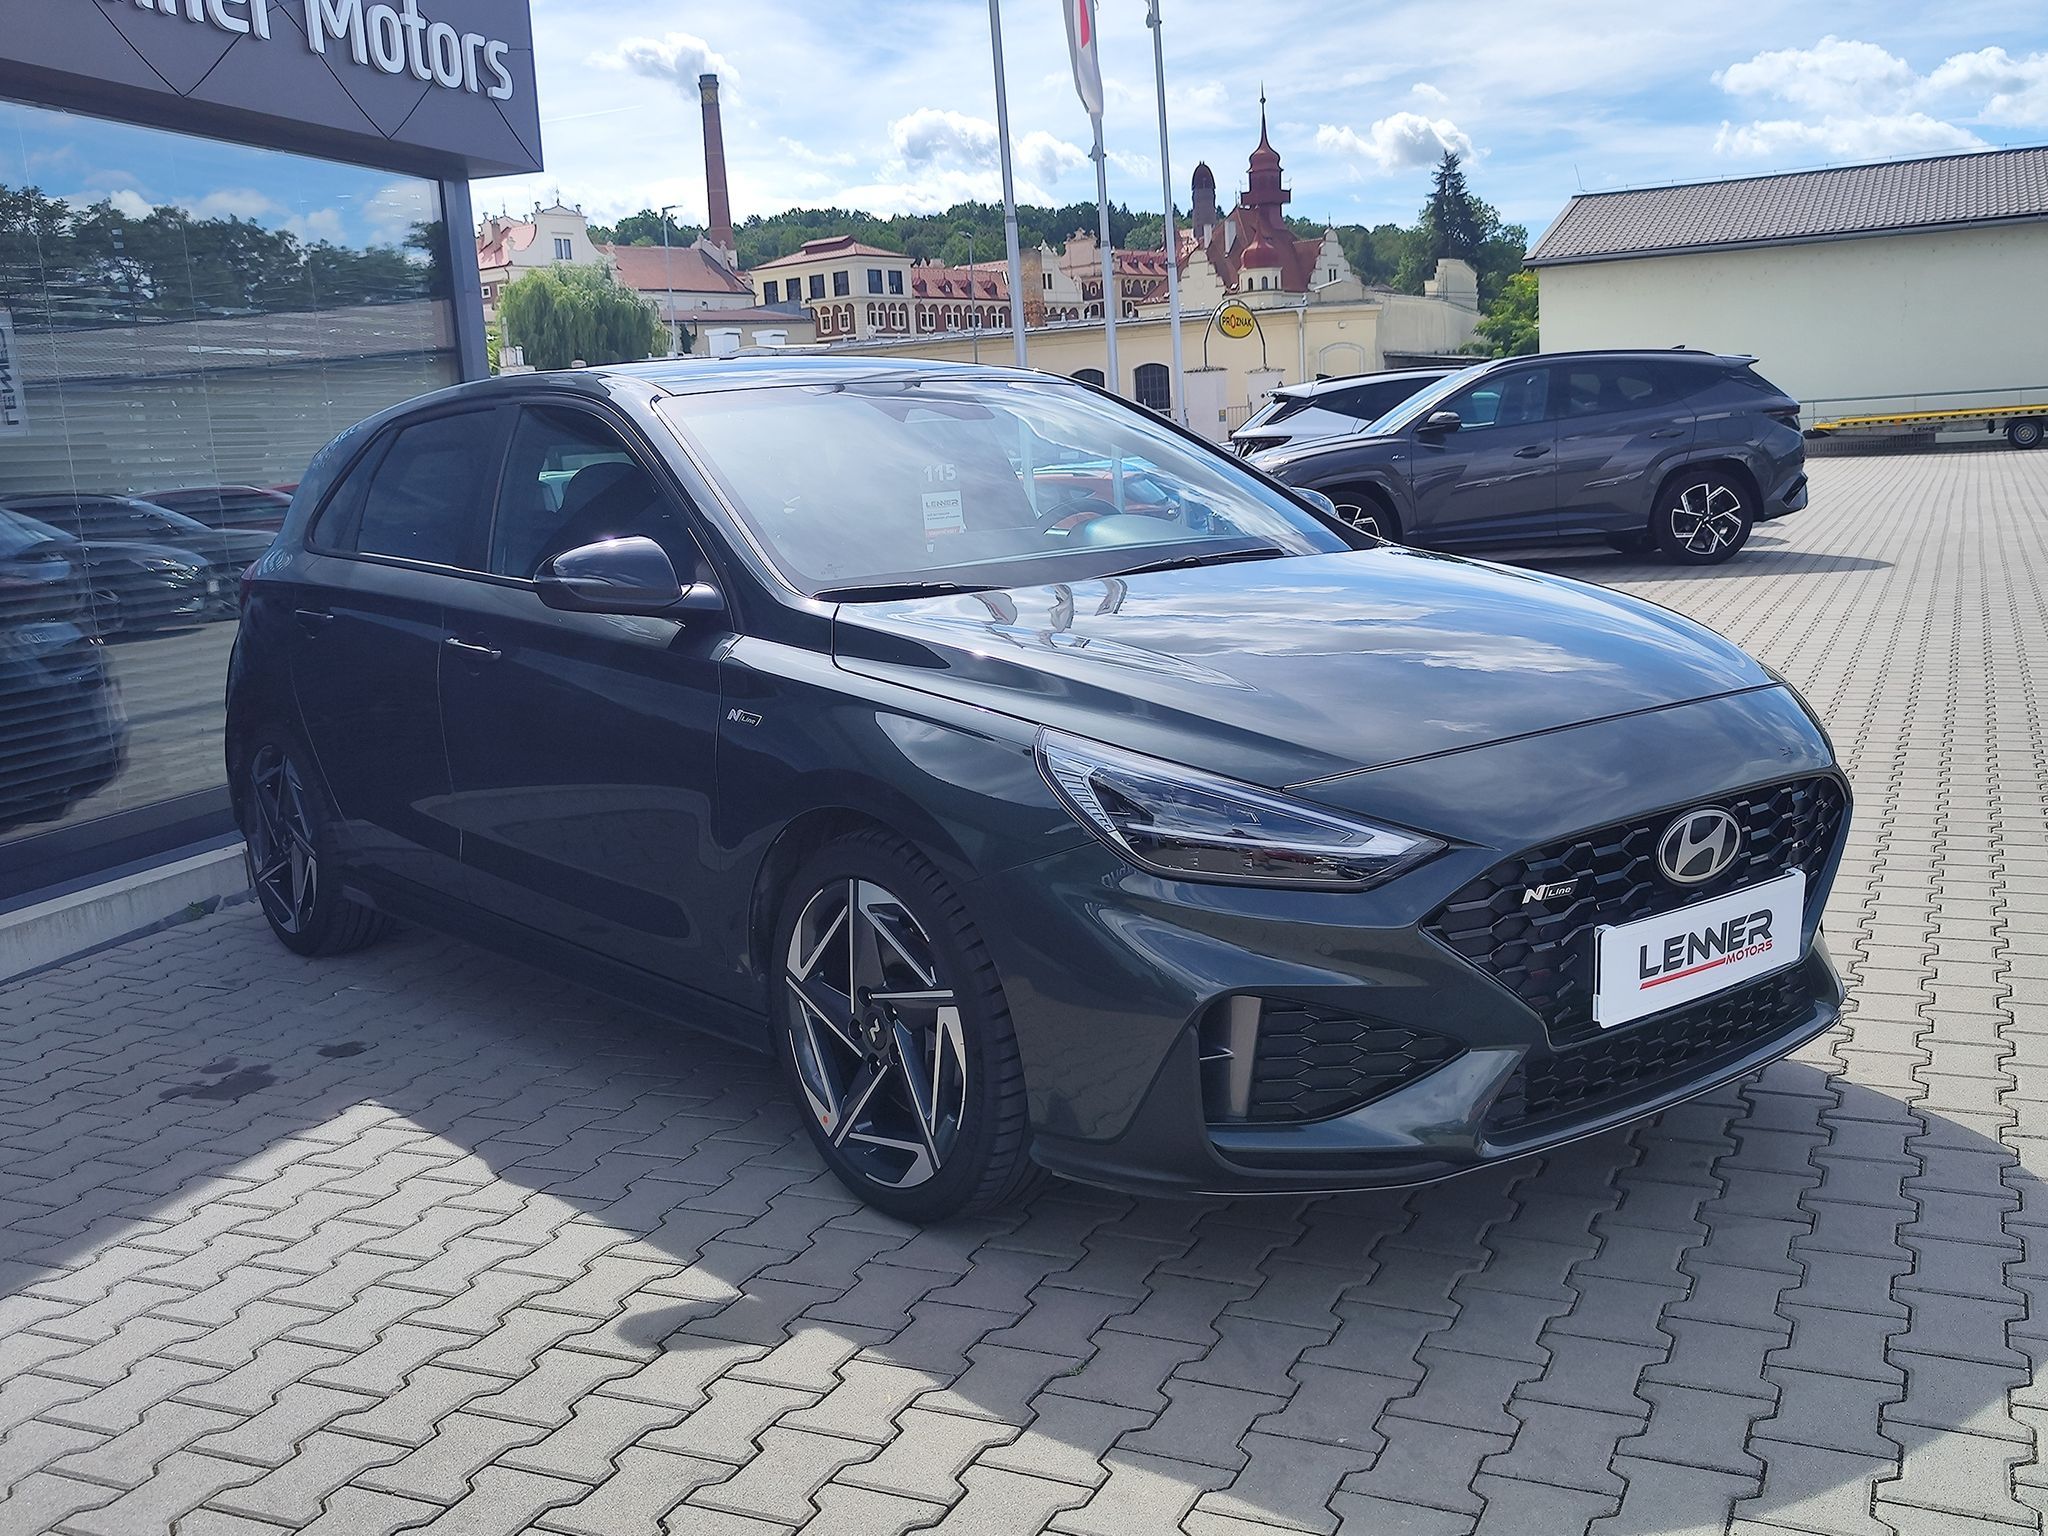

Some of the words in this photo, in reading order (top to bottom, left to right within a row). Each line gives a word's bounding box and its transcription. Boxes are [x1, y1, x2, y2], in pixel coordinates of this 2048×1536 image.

[304, 0, 514, 101] Motors
[923, 463, 957, 482] 115
[726, 708, 743, 722] N
[1521, 884, 1547, 905] N
[1547, 886, 1572, 898] Line
[1639, 908, 1773, 980] LENNER
[1725, 938, 1773, 965] MOTORS
